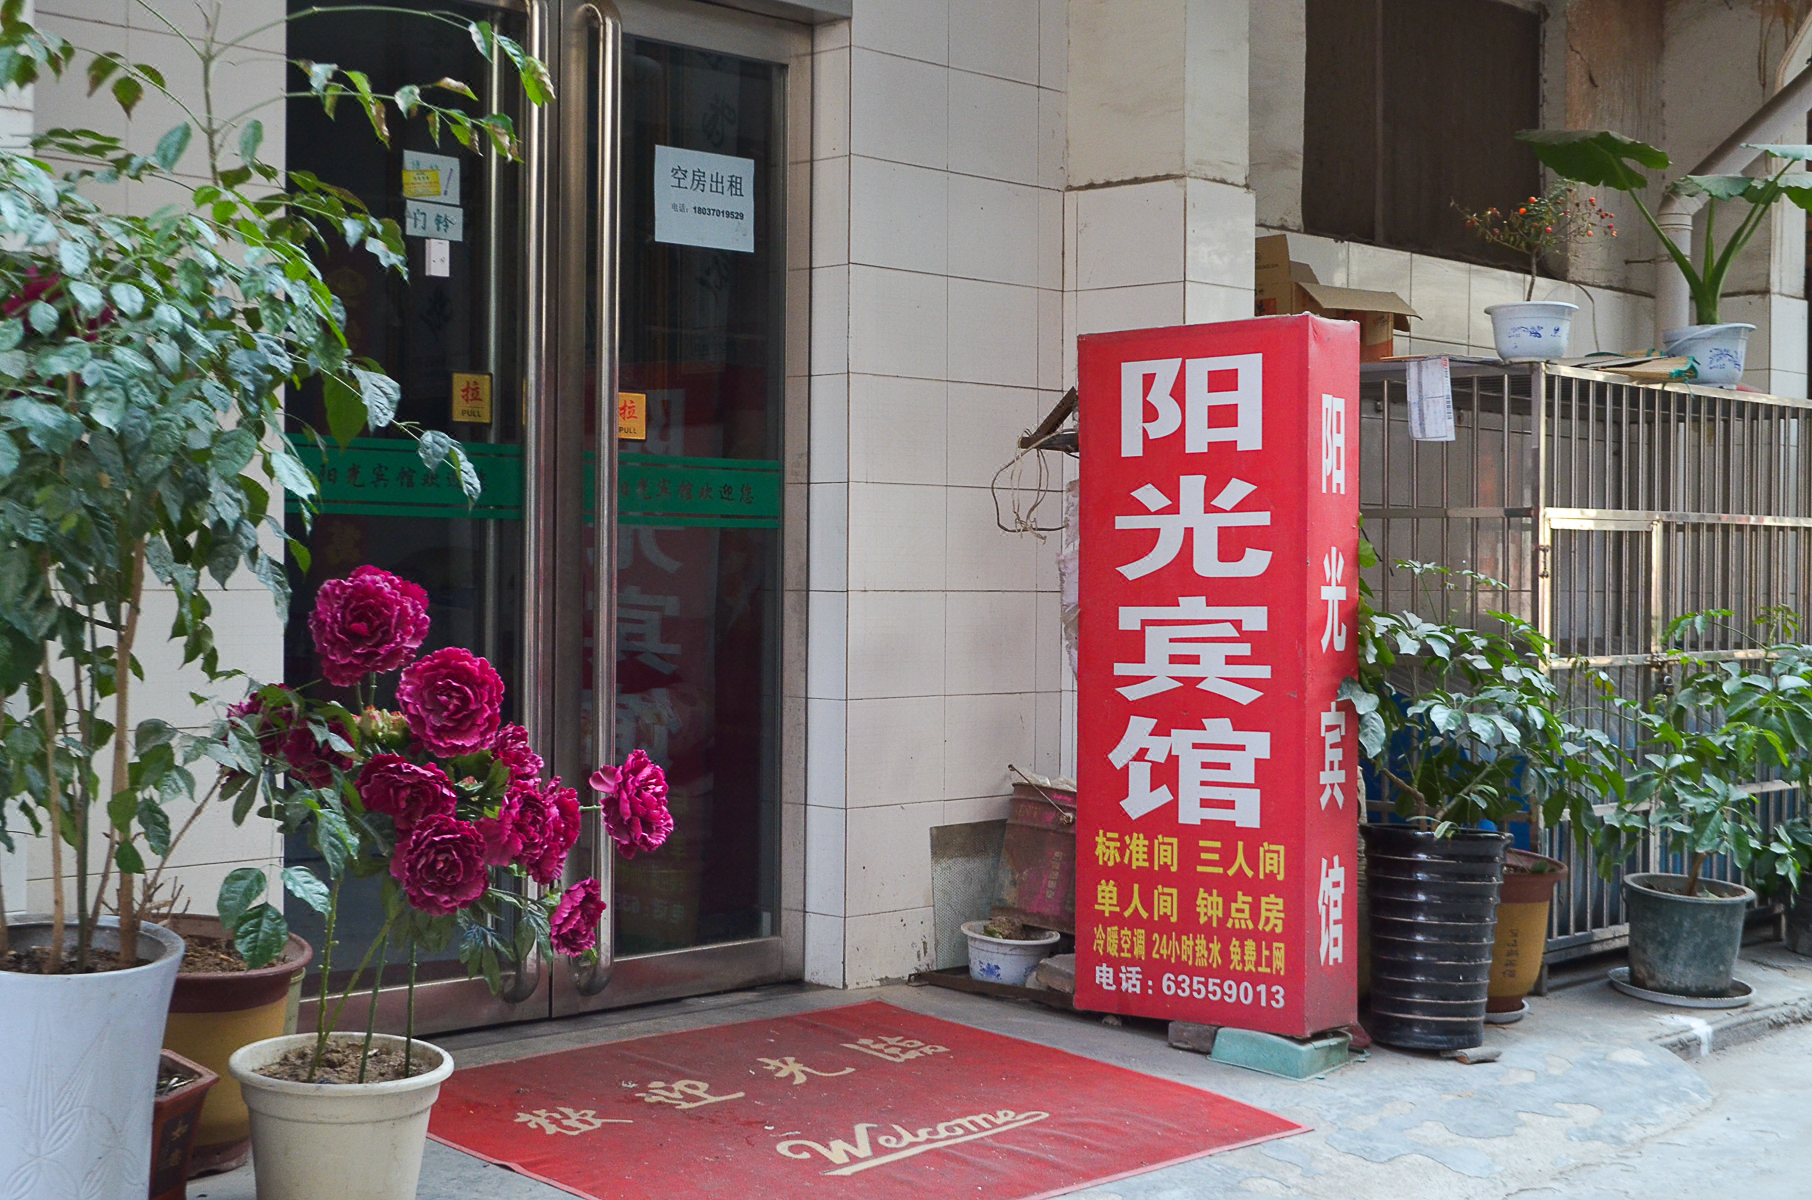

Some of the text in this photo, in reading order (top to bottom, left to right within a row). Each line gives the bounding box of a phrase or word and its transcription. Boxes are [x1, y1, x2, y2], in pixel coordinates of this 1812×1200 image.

[670, 164, 745, 198] 空房出租
[460, 380, 484, 404] 拉
[461, 409, 482, 419] PULL
[618, 399, 639, 422] 拉
[618, 426, 637, 436] PULL
[1107, 352, 1273, 829] 阳光宾馆
[1317, 392, 1347, 968] 阳光宾馆
[1094, 829, 1286, 881] 标准间 三人间
[1094, 879, 1286, 934] 单人间 钟点房
[1093, 923, 1286, 977] 冷暖空调 24小时热水 免费上网
[775, 1109, 1050, 1175] Welcome
